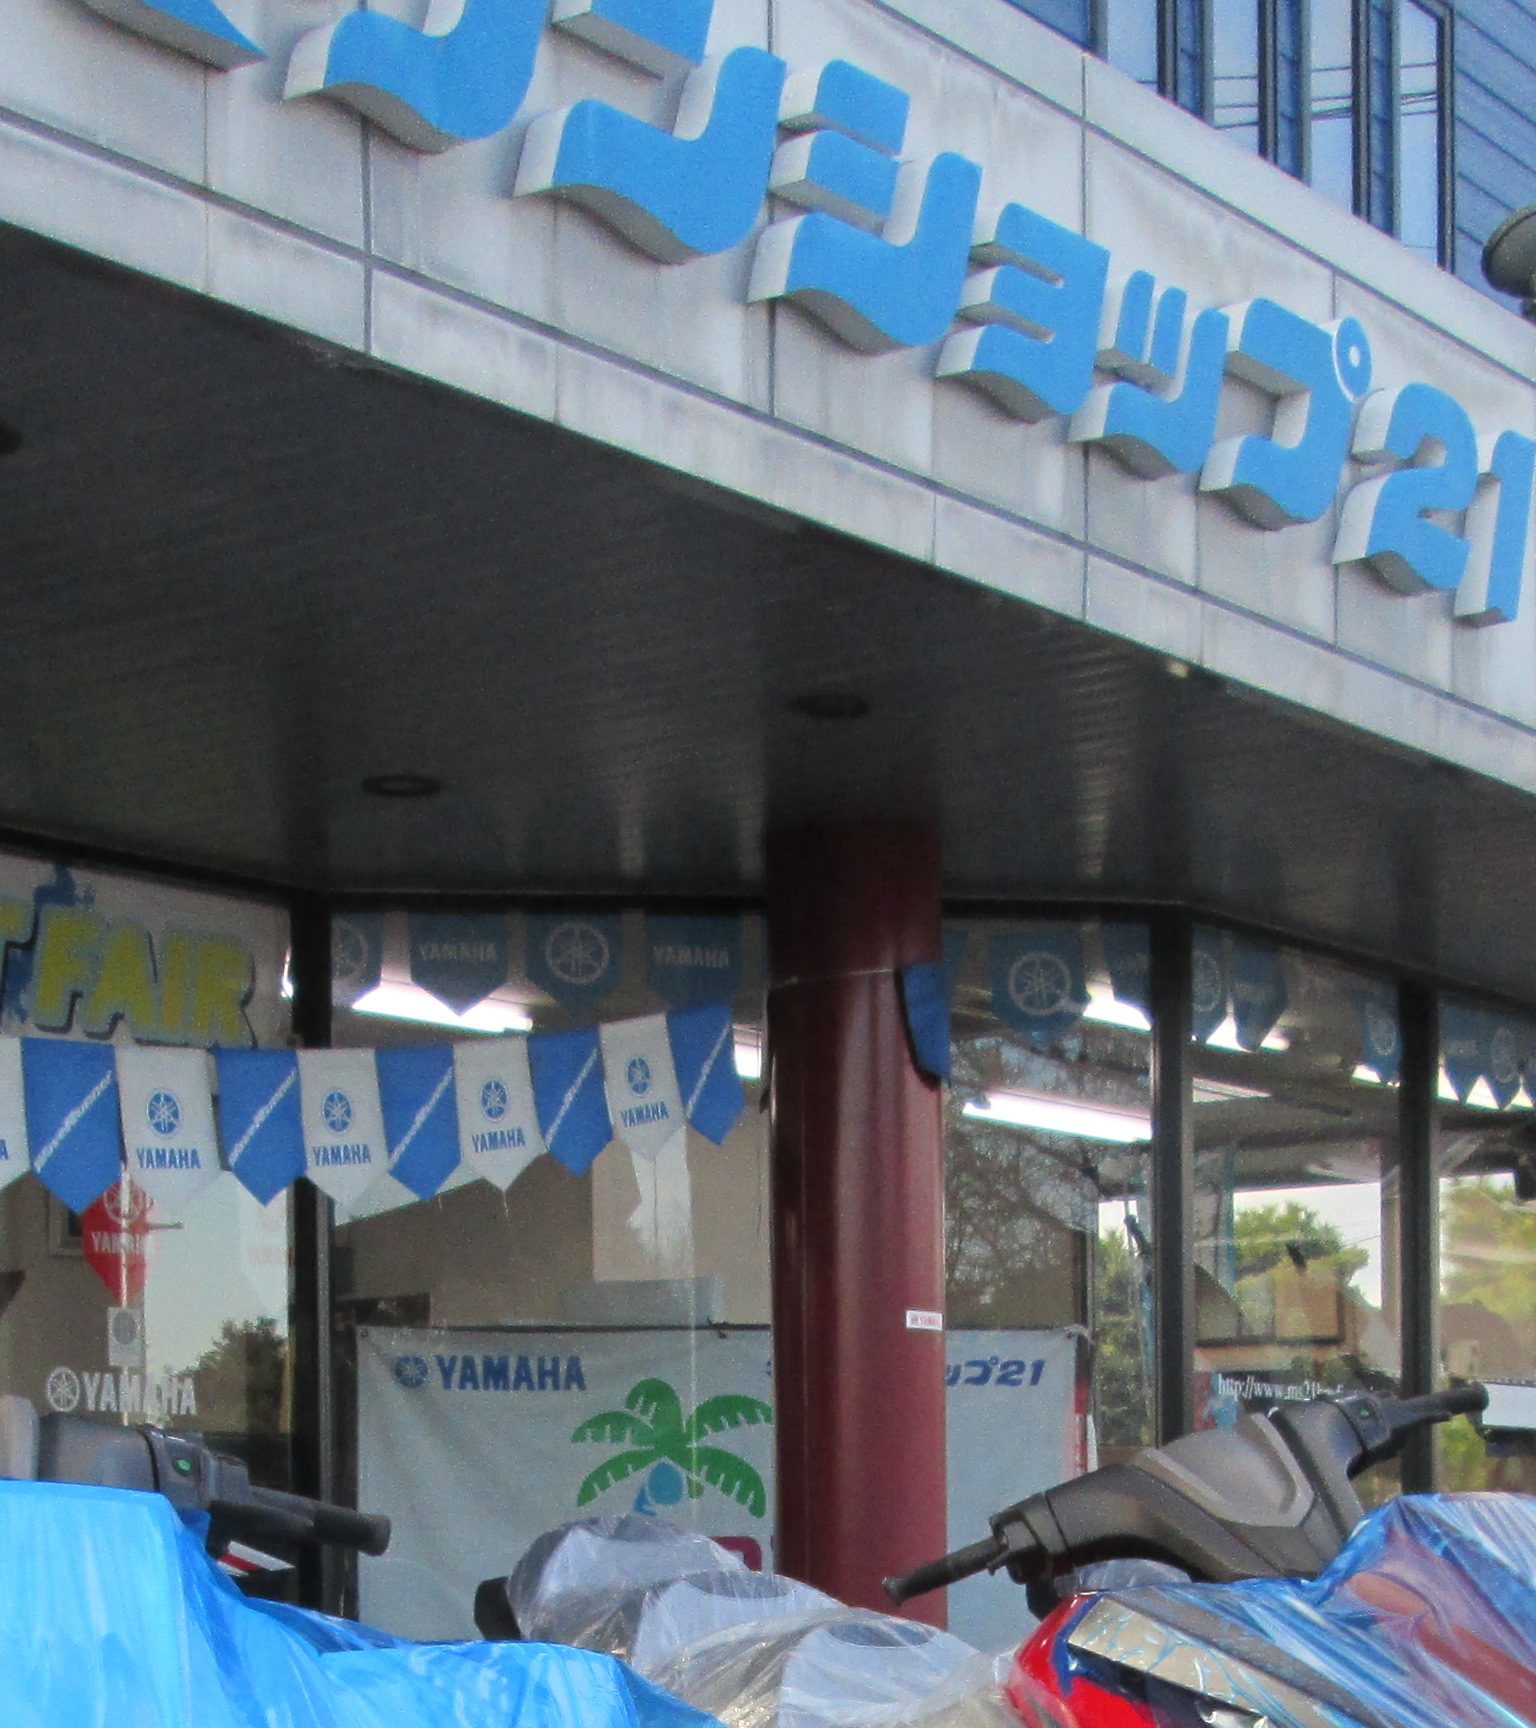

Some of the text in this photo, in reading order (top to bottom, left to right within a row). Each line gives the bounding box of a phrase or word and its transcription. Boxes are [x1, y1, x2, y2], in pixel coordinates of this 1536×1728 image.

[62, 0, 1536, 628] ンショップ21
[34, 909, 252, 1040] FAIR
[620, 1100, 670, 1128] YAMAHA
[313, 1143, 372, 1166] YAMAHA
[471, 1126, 526, 1153] YAMAHA
[136, 1147, 202, 1170] YAMAHA
[435, 1354, 587, 1391] YAMAHA
[82, 1371, 198, 1415] YAMAHA
